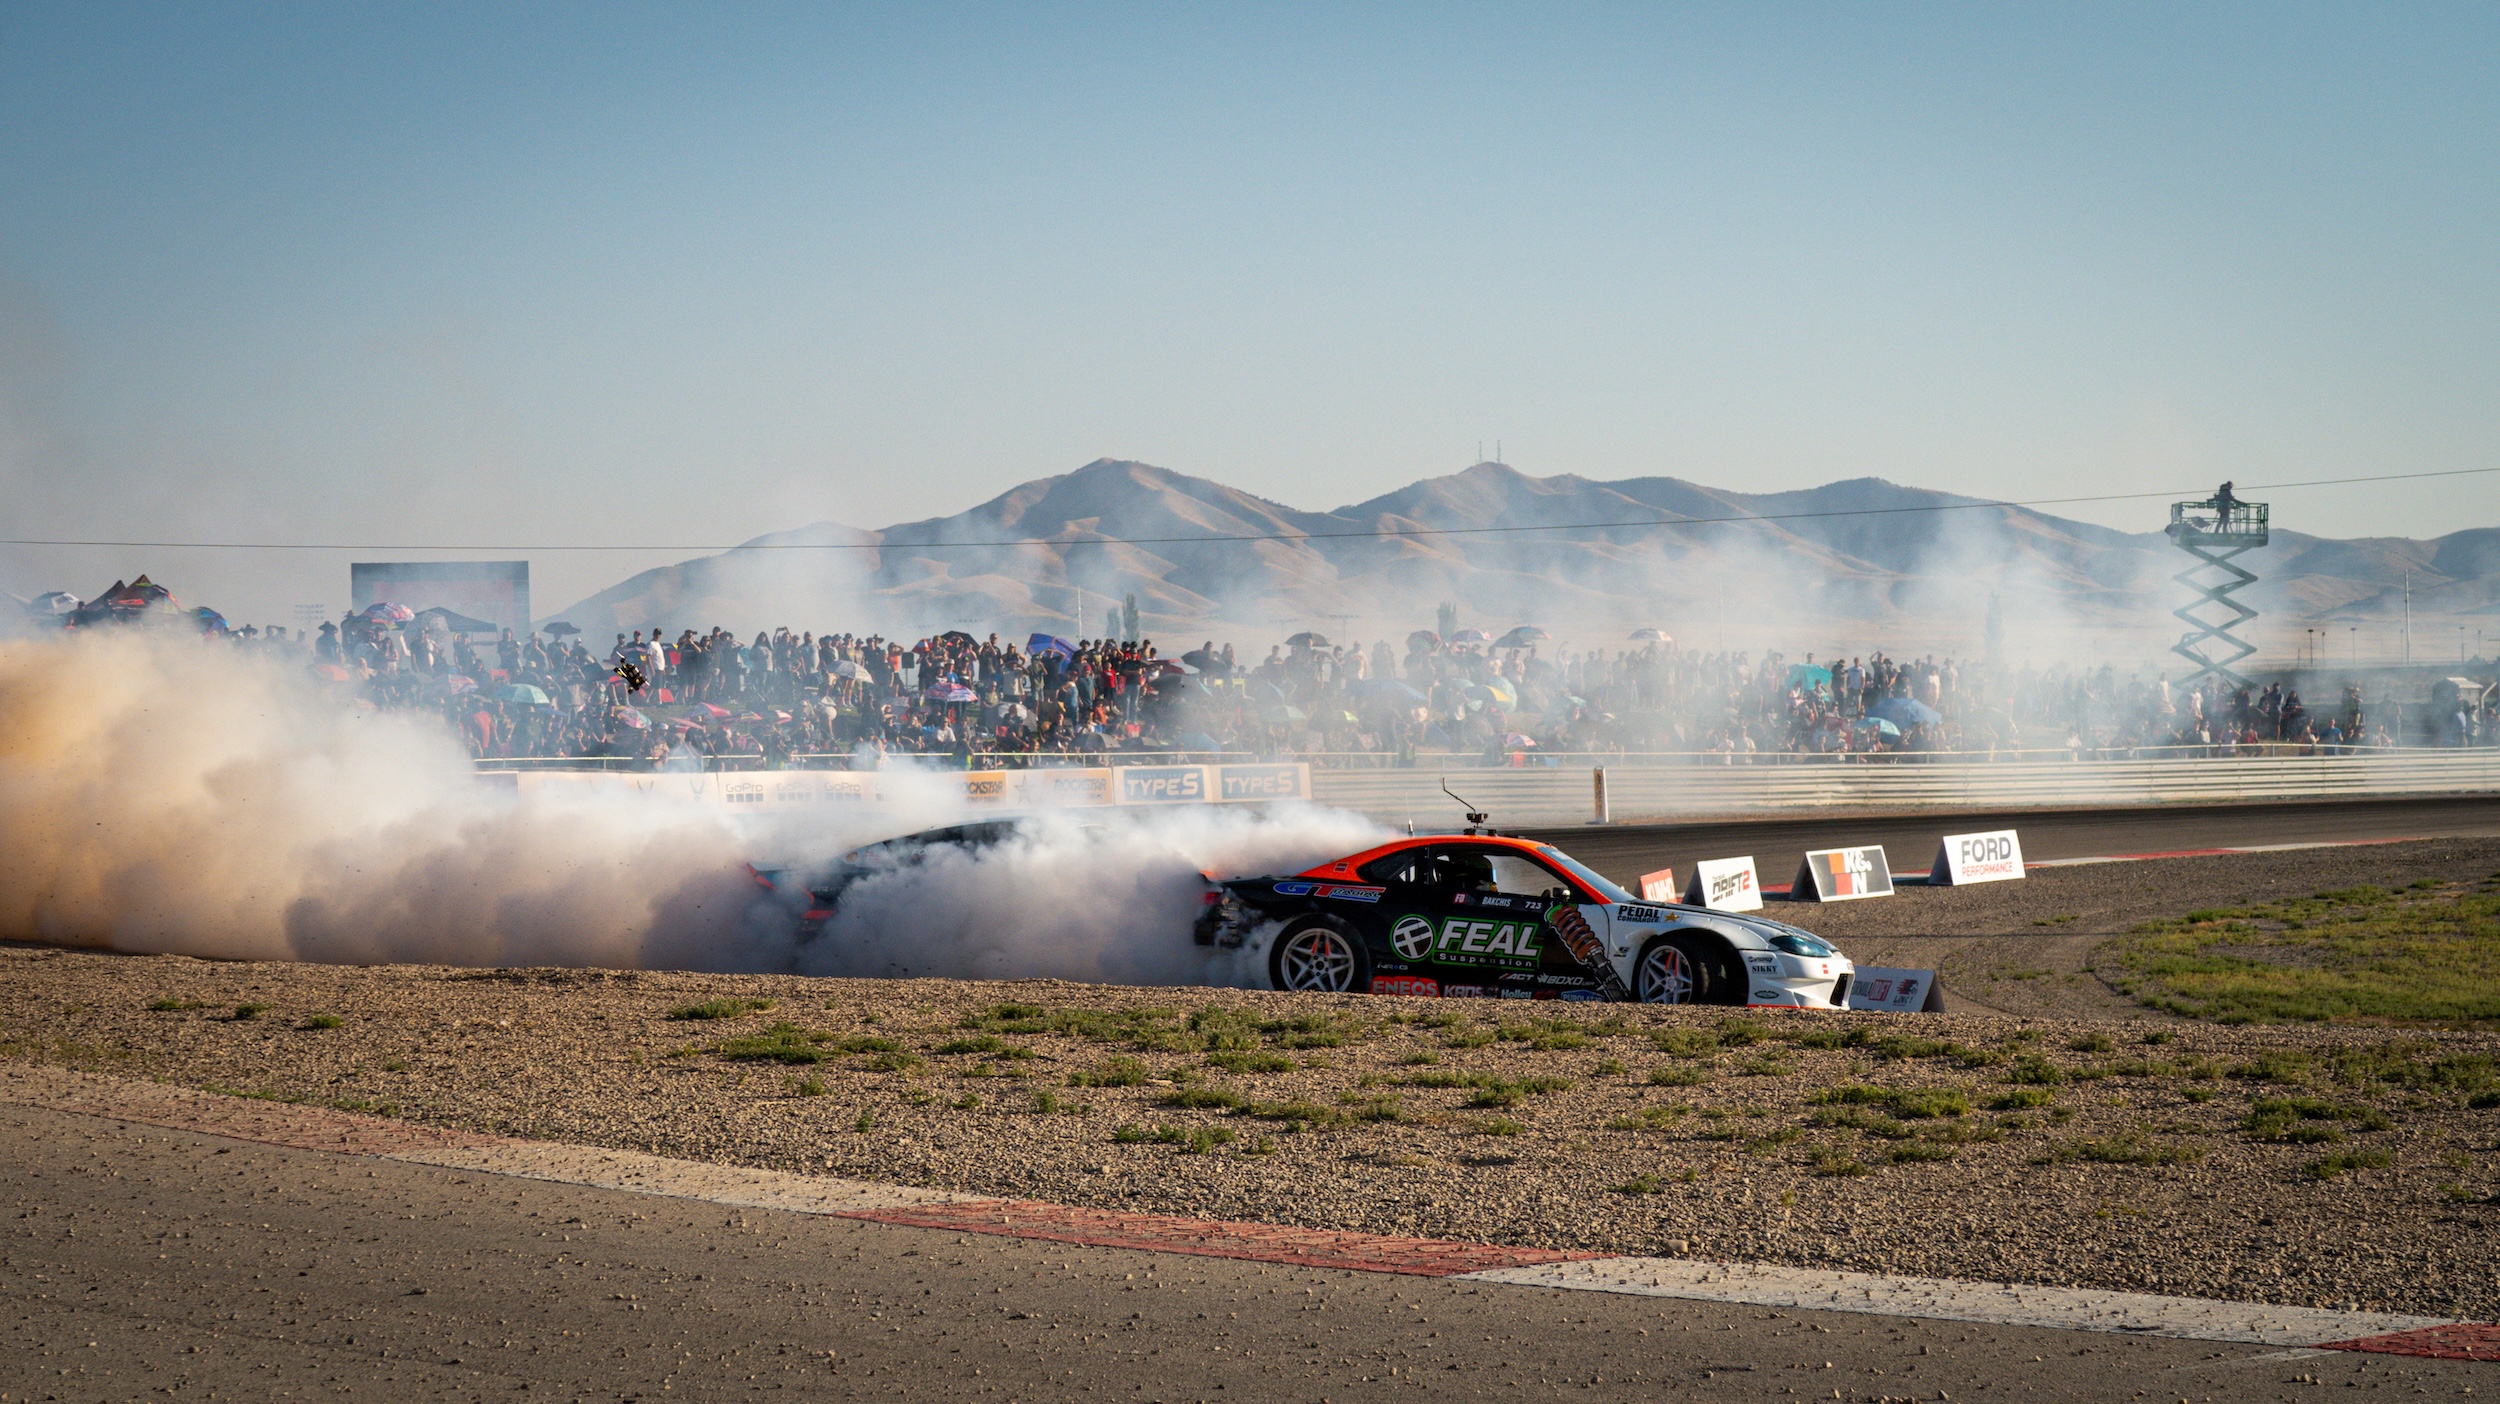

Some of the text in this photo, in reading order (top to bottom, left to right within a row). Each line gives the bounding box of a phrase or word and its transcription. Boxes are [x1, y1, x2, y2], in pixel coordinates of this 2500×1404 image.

[726, 783, 764, 792] GoPro
[824, 782, 861, 792] GoPro
[1961, 836, 2012, 864] FORD
[1962, 861, 2013, 877] PERFORMANCE
[1482, 896, 1512, 907] BAKCHIS
[1525, 901, 1543, 910] 723
[1618, 905, 1660, 919] PEDAL
[1437, 919, 1539, 957] FEAL
[1439, 953, 1533, 968] Suspension
[1752, 965, 1778, 973] SIKKY
[1372, 980, 1438, 997] ENEOS
[1501, 988, 1532, 1000] Holley
